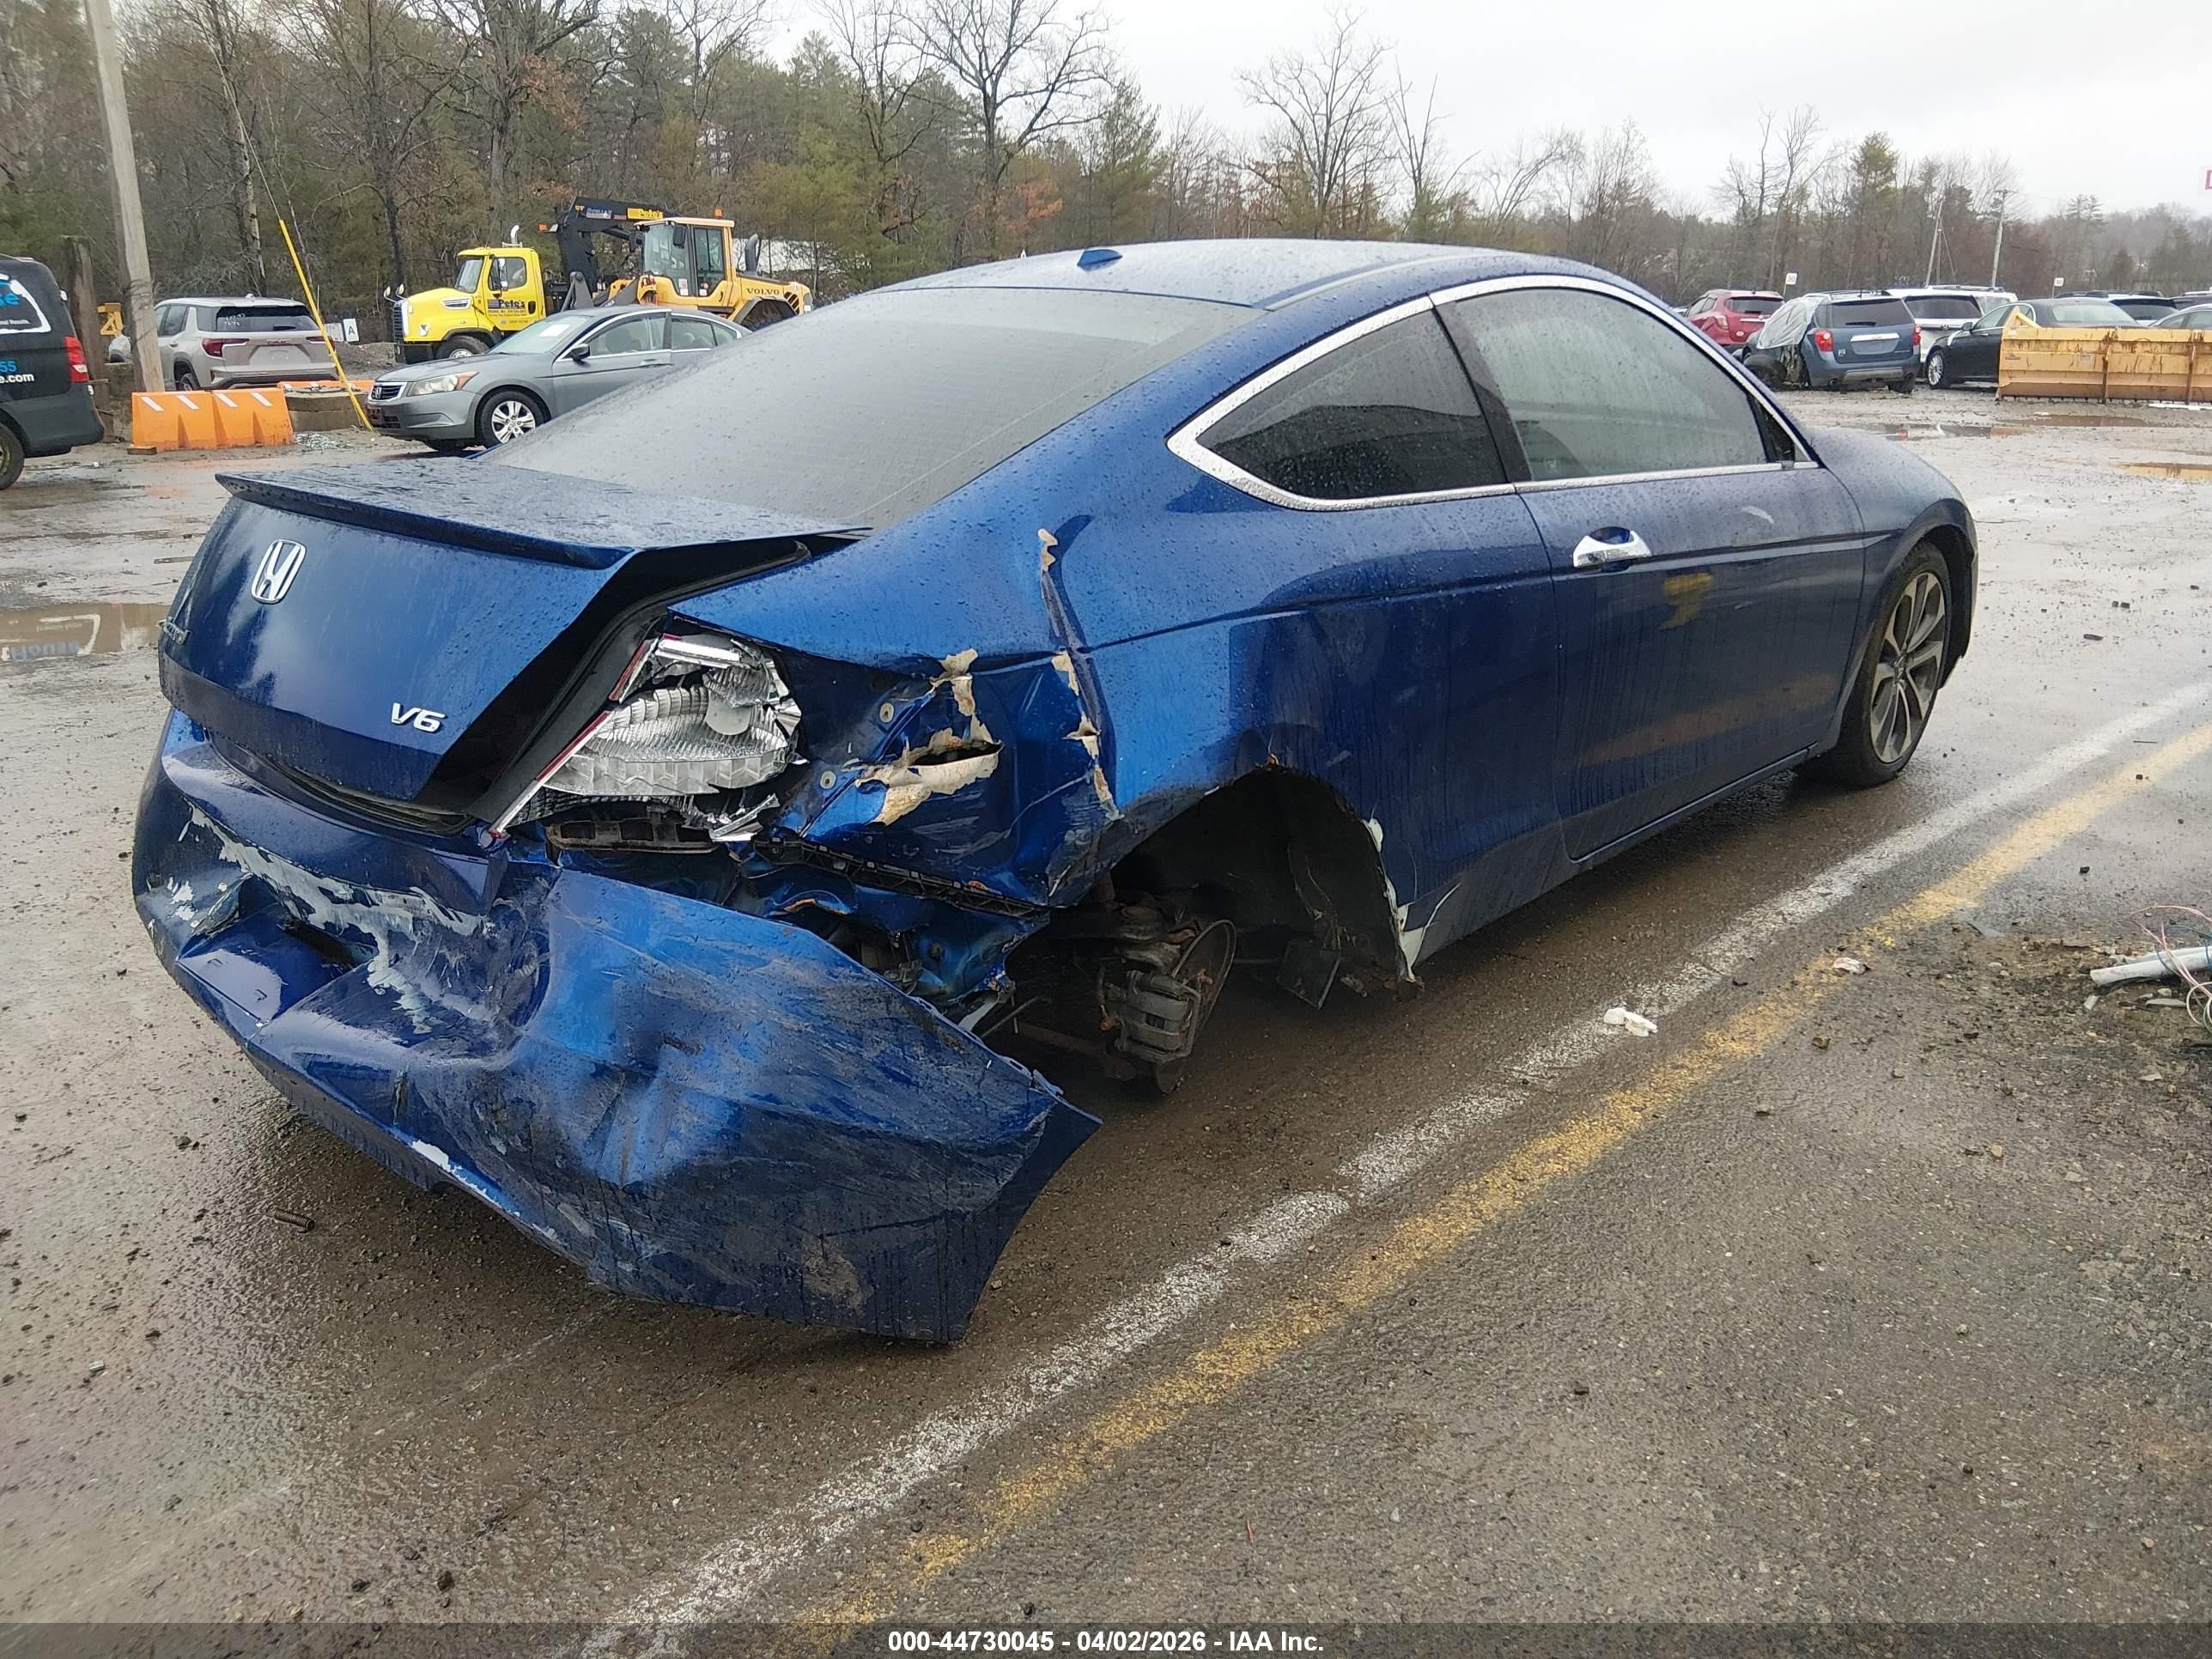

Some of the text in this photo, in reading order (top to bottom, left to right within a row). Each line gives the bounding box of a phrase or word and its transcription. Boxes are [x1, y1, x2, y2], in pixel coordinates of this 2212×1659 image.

[499, 299, 526, 309] Pete's
[348, 325, 356, 336] A
[392, 702, 446, 732] V6
